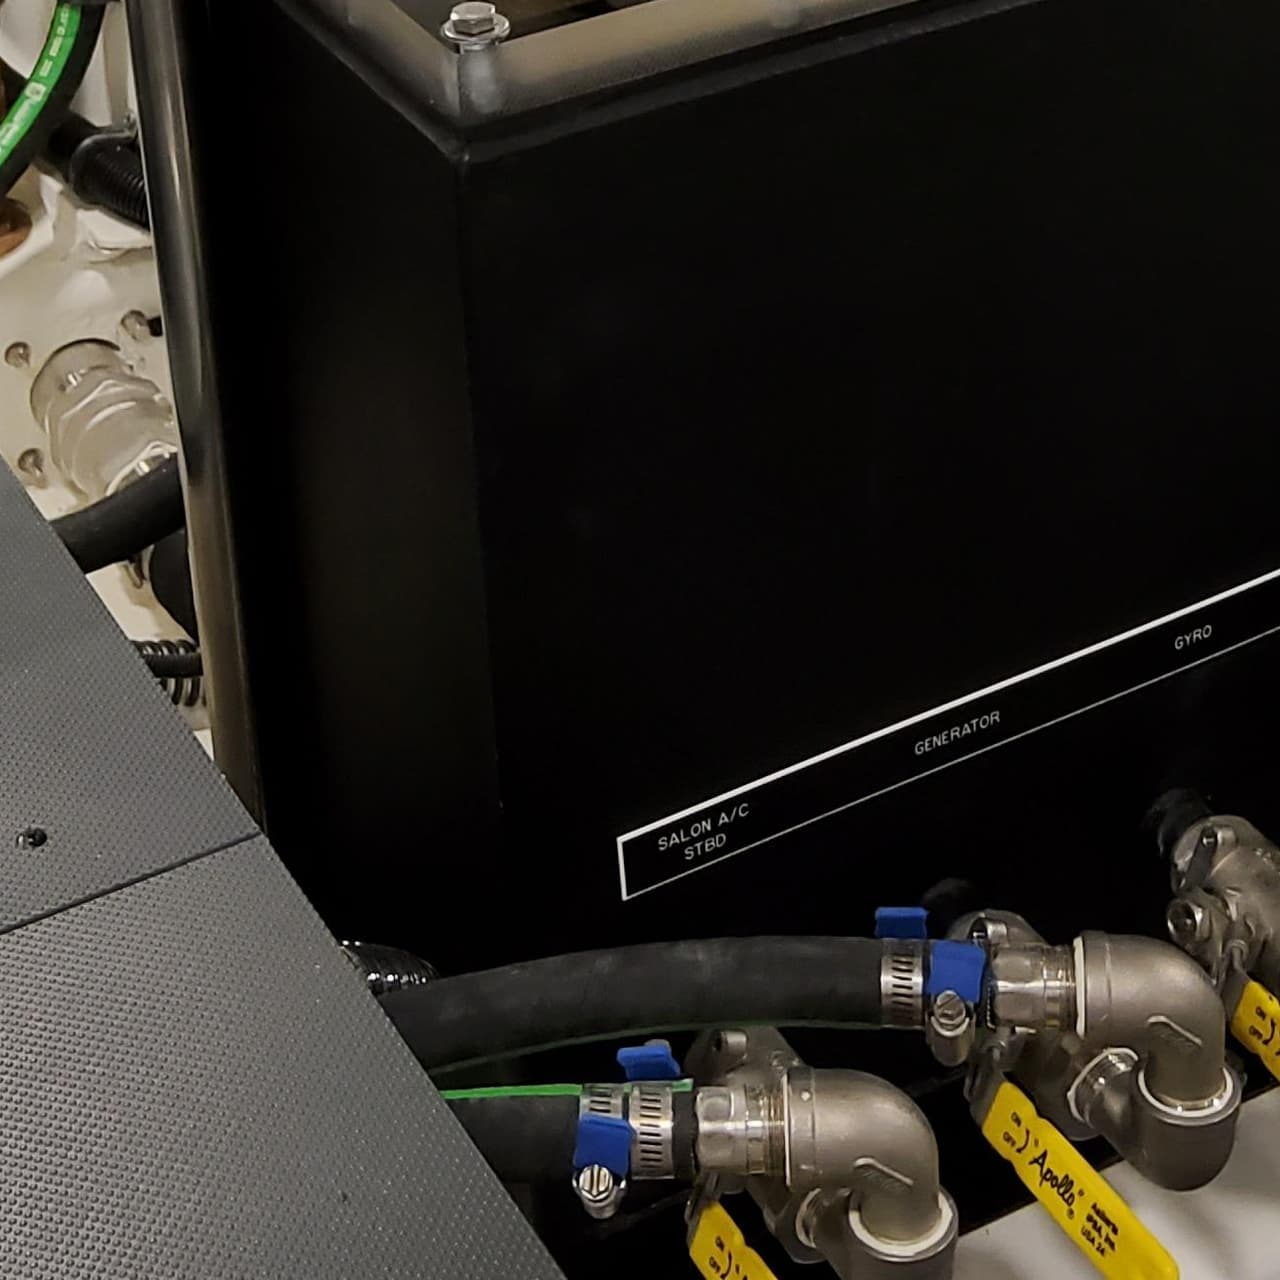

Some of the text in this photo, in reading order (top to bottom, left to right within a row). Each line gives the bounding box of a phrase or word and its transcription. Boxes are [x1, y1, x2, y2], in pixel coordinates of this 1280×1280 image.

[1174, 624, 1212, 650] GYRO
[914, 710, 1000, 755] GENERATOR
[658, 803, 749, 851] SALON A/C
[684, 833, 726, 860] STBD
